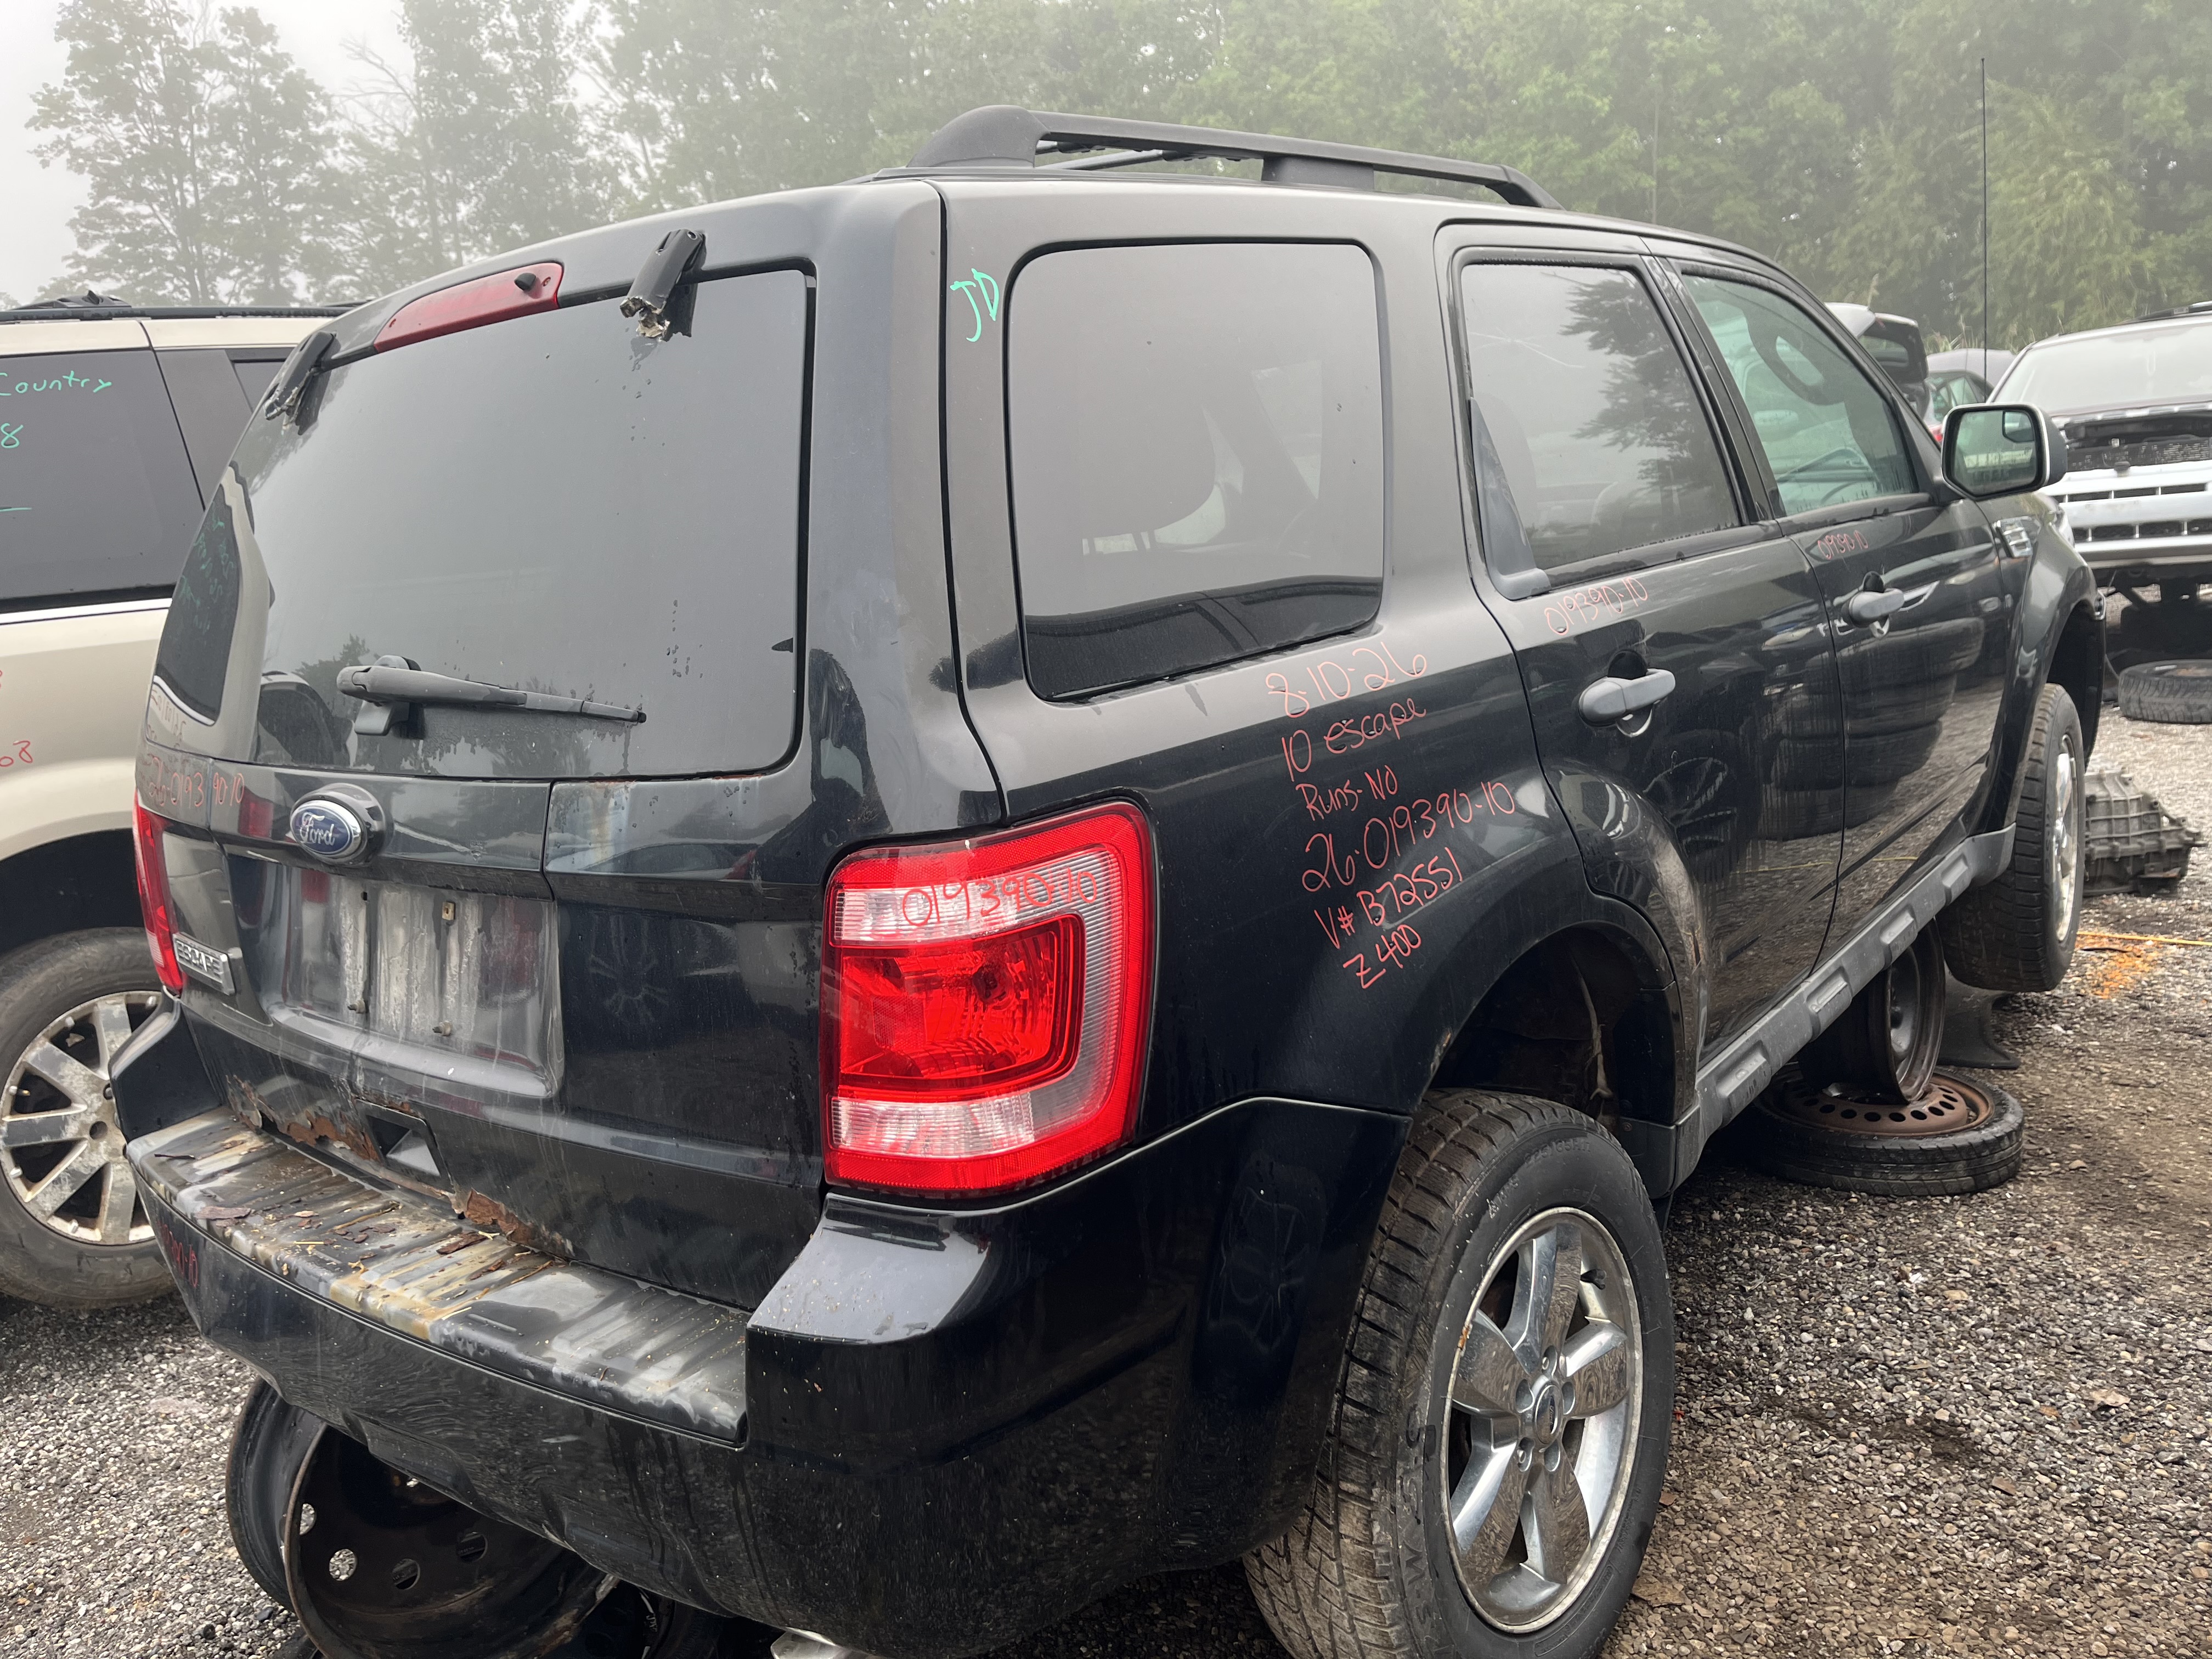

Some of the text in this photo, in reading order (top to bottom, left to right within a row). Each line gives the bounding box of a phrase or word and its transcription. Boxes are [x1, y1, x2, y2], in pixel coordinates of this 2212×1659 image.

[949, 268, 1000, 342] JD
[1544, 576, 1649, 636] 019390-10
[1282, 698, 1426, 782] 10 escape
[300, 811, 336, 846] Ford
[901, 867, 1098, 927] 019390-10
[1356, 847, 1463, 927] B72551
[175, 939, 222, 979] ESCAPE
